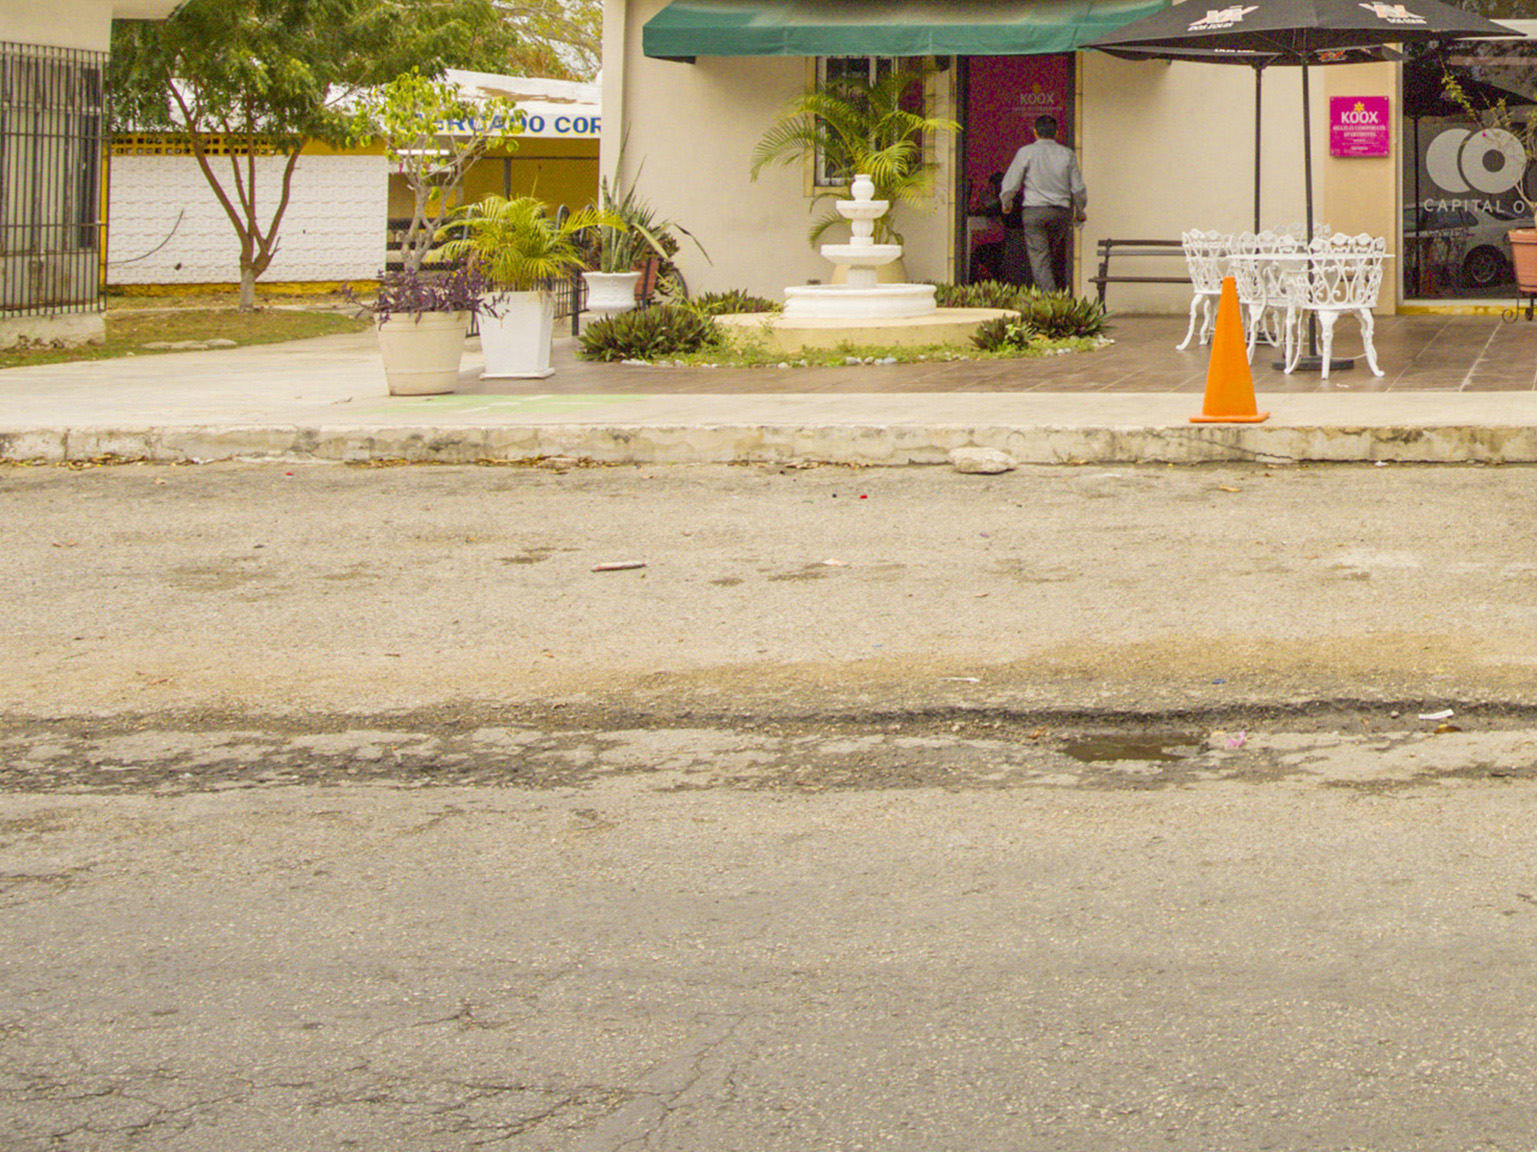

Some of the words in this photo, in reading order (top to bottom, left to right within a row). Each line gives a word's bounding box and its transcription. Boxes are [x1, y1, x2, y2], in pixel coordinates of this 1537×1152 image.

[1341, 111, 1379, 124] KOOX
[1423, 198, 1505, 213] CAPITAL
[1513, 200, 1526, 214] O
